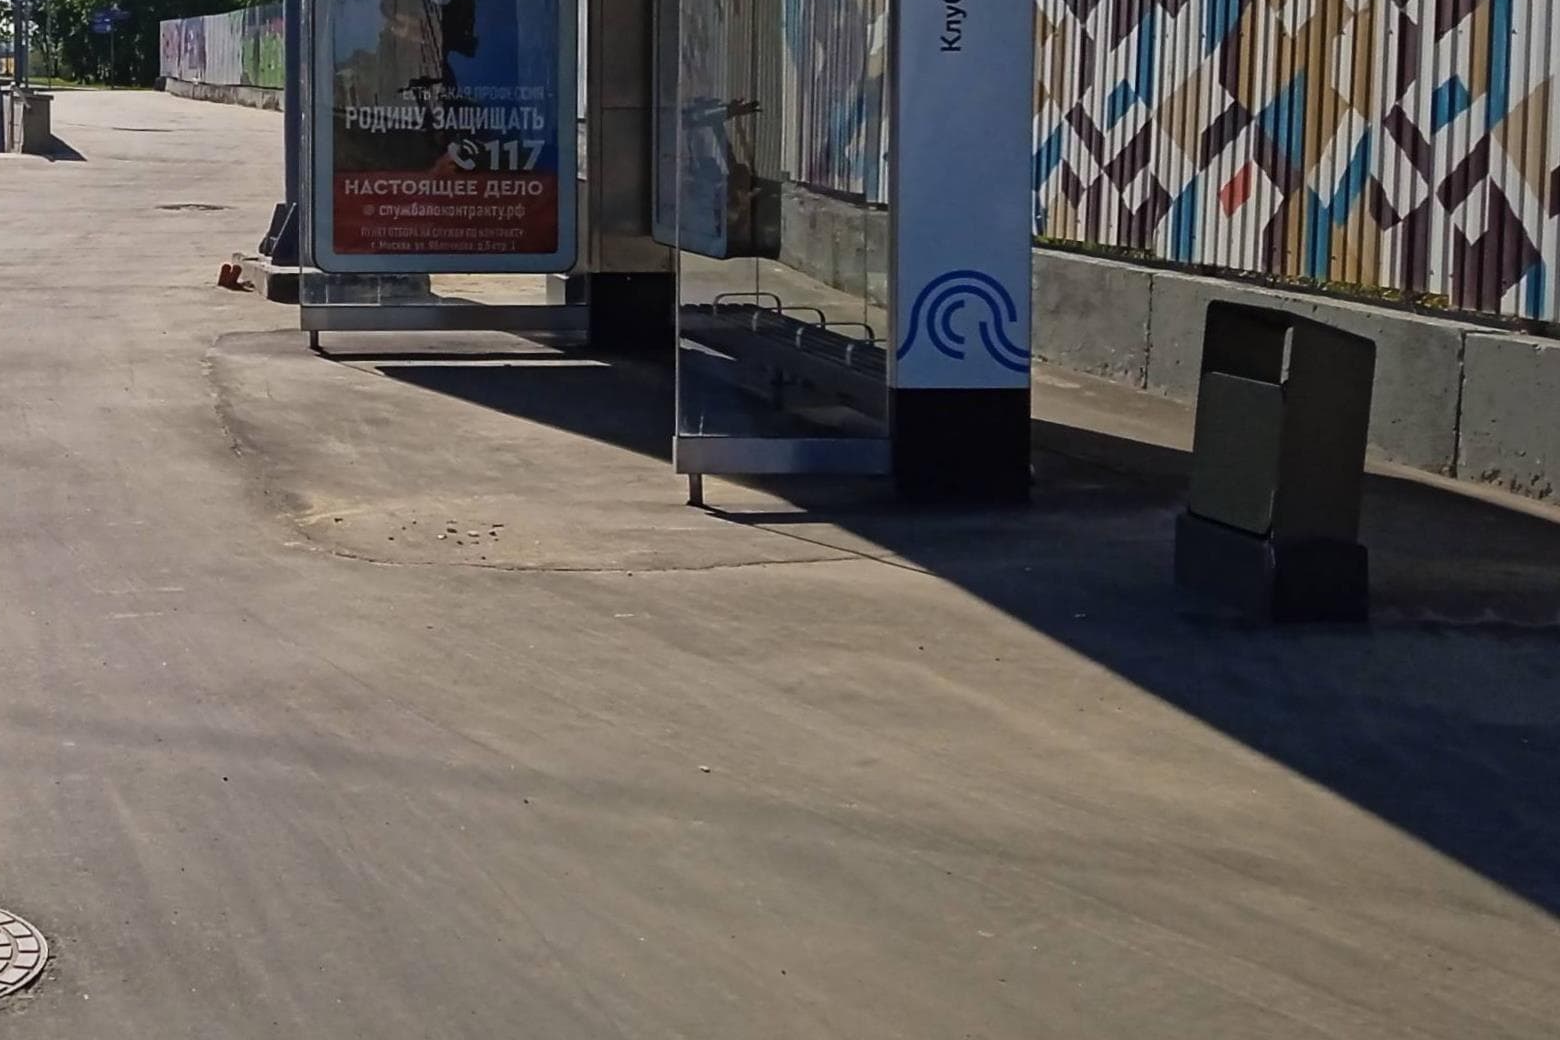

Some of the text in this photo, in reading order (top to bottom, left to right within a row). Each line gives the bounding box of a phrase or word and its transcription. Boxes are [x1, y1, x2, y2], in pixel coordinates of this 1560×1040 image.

[345, 106, 544, 135] РОДИНУ ЗАЩИЩАТЬ
[483, 139, 546, 171] 117
[344, 179, 543, 198] НАСТОЯЩЕЕ ДЕЛО
[378, 202, 526, 220] службапоконтракту.рф
